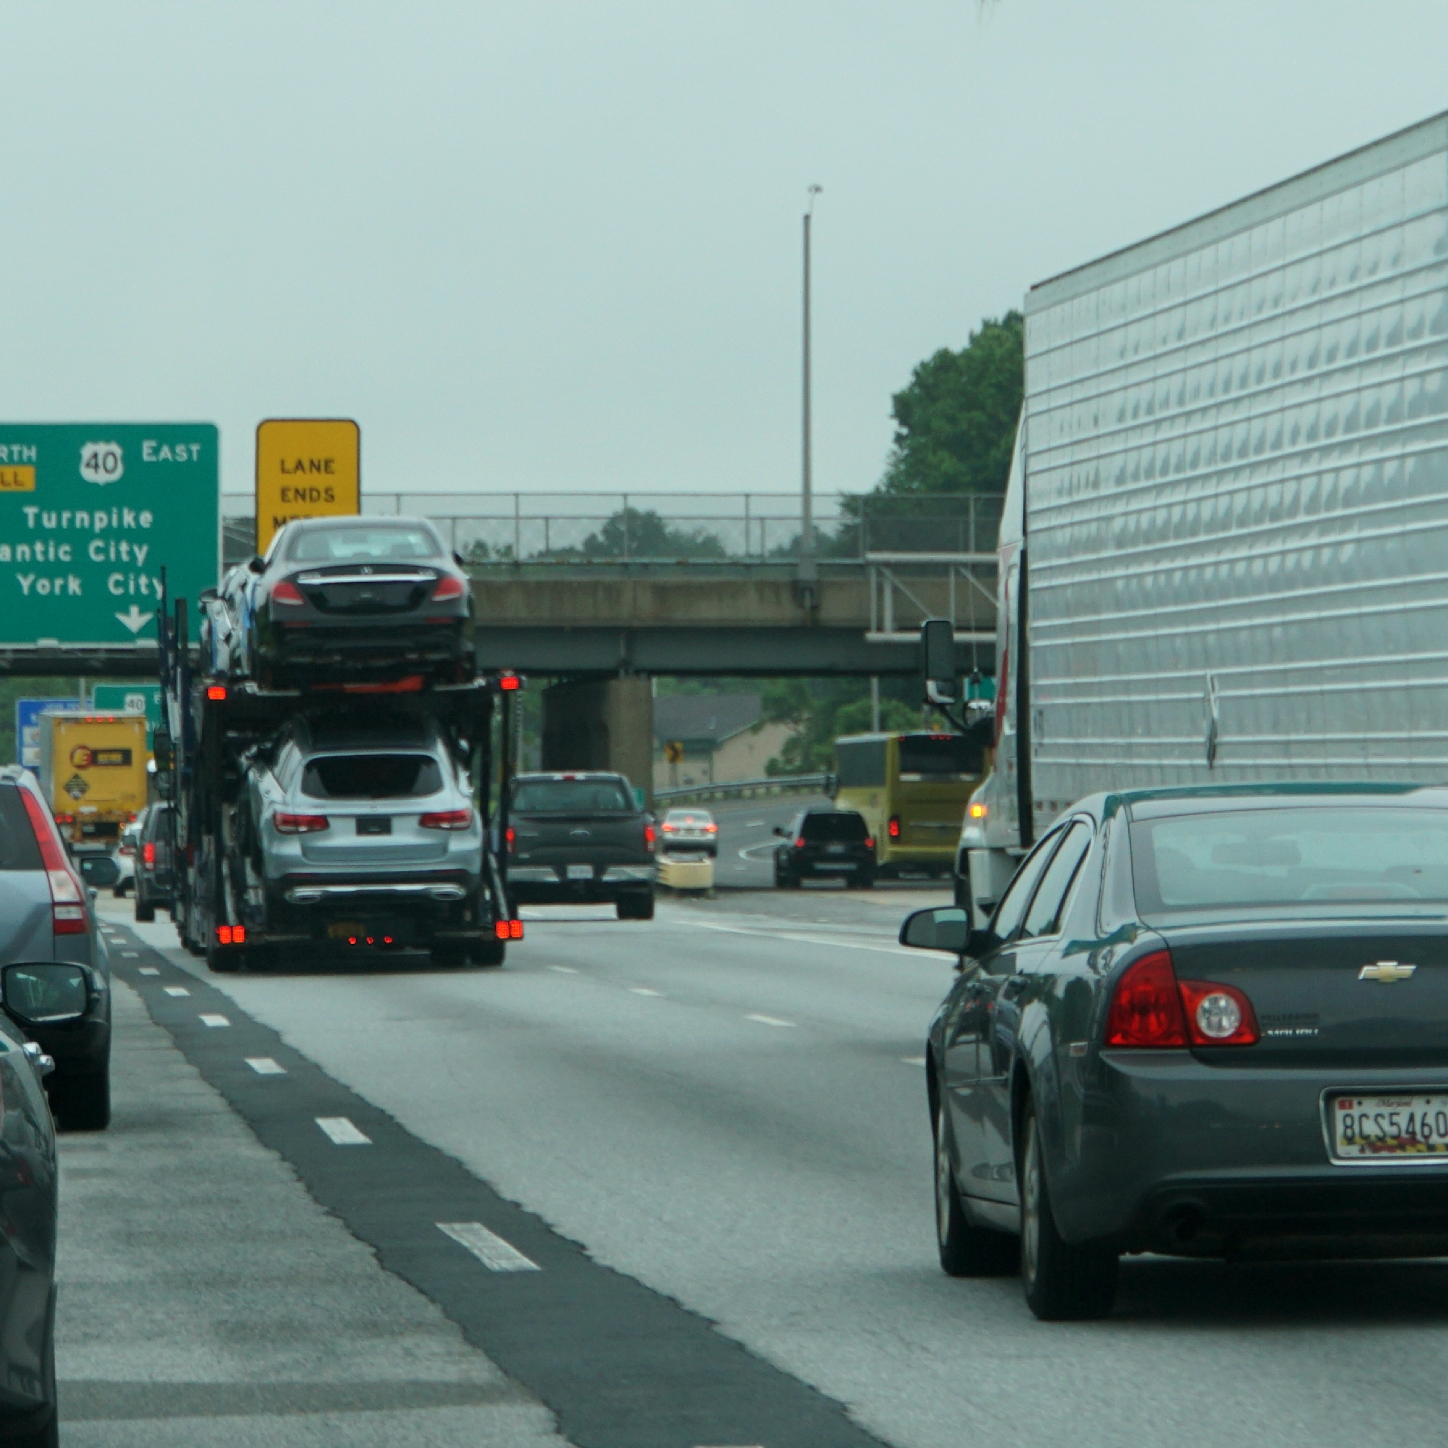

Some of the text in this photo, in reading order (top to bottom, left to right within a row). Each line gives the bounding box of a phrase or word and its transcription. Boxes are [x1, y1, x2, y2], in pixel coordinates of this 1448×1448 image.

[84, 451, 118, 475] 40
[142, 439, 201, 462] EAST
[280, 458, 335, 474] LANE
[280, 486, 335, 503] ENDS
[22, 506, 154, 533] Turnpike
[88, 539, 149, 567] City
[15, 573, 83, 596] York
[107, 572, 164, 601] City
[126, 698, 144, 712] 40
[1342, 1111, 1448, 1140] 8CS5460
